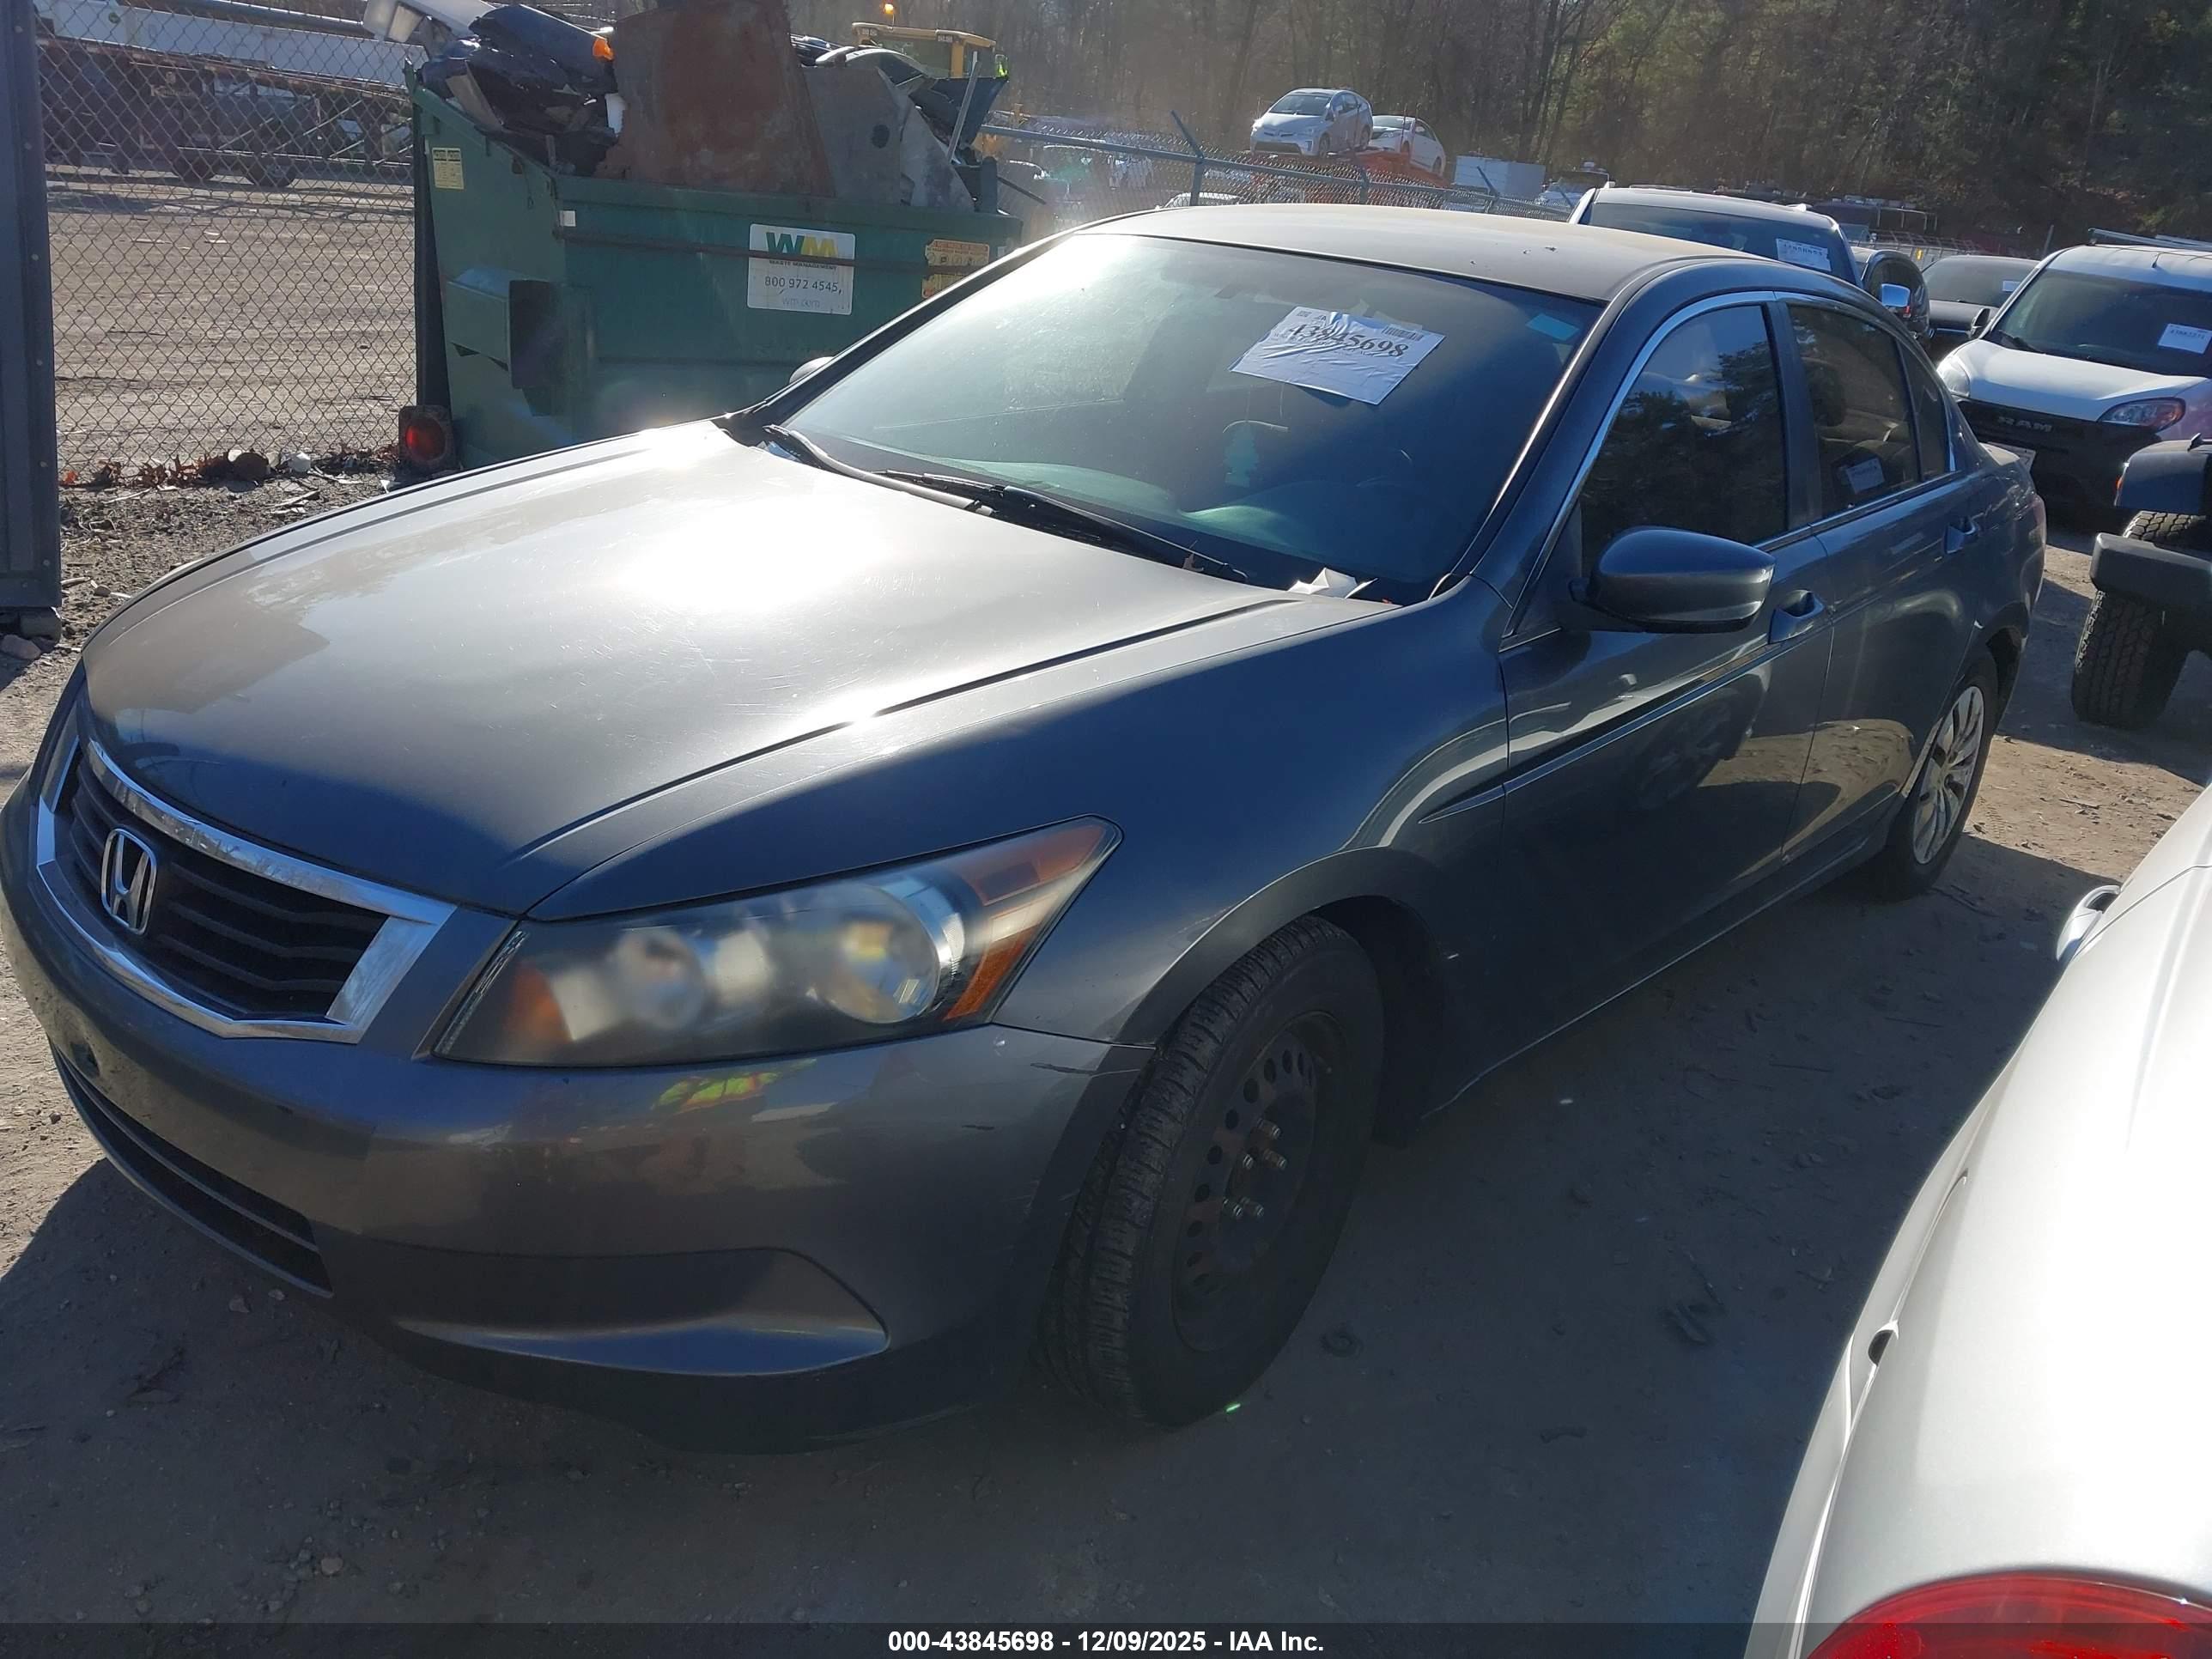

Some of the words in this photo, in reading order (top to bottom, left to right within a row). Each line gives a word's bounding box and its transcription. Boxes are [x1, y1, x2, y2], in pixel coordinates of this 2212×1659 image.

[766, 232, 838, 258] WM
[764, 276, 786, 288] 800
[788, 278, 809, 289] 972
[1997, 416, 2052, 432] RAM
